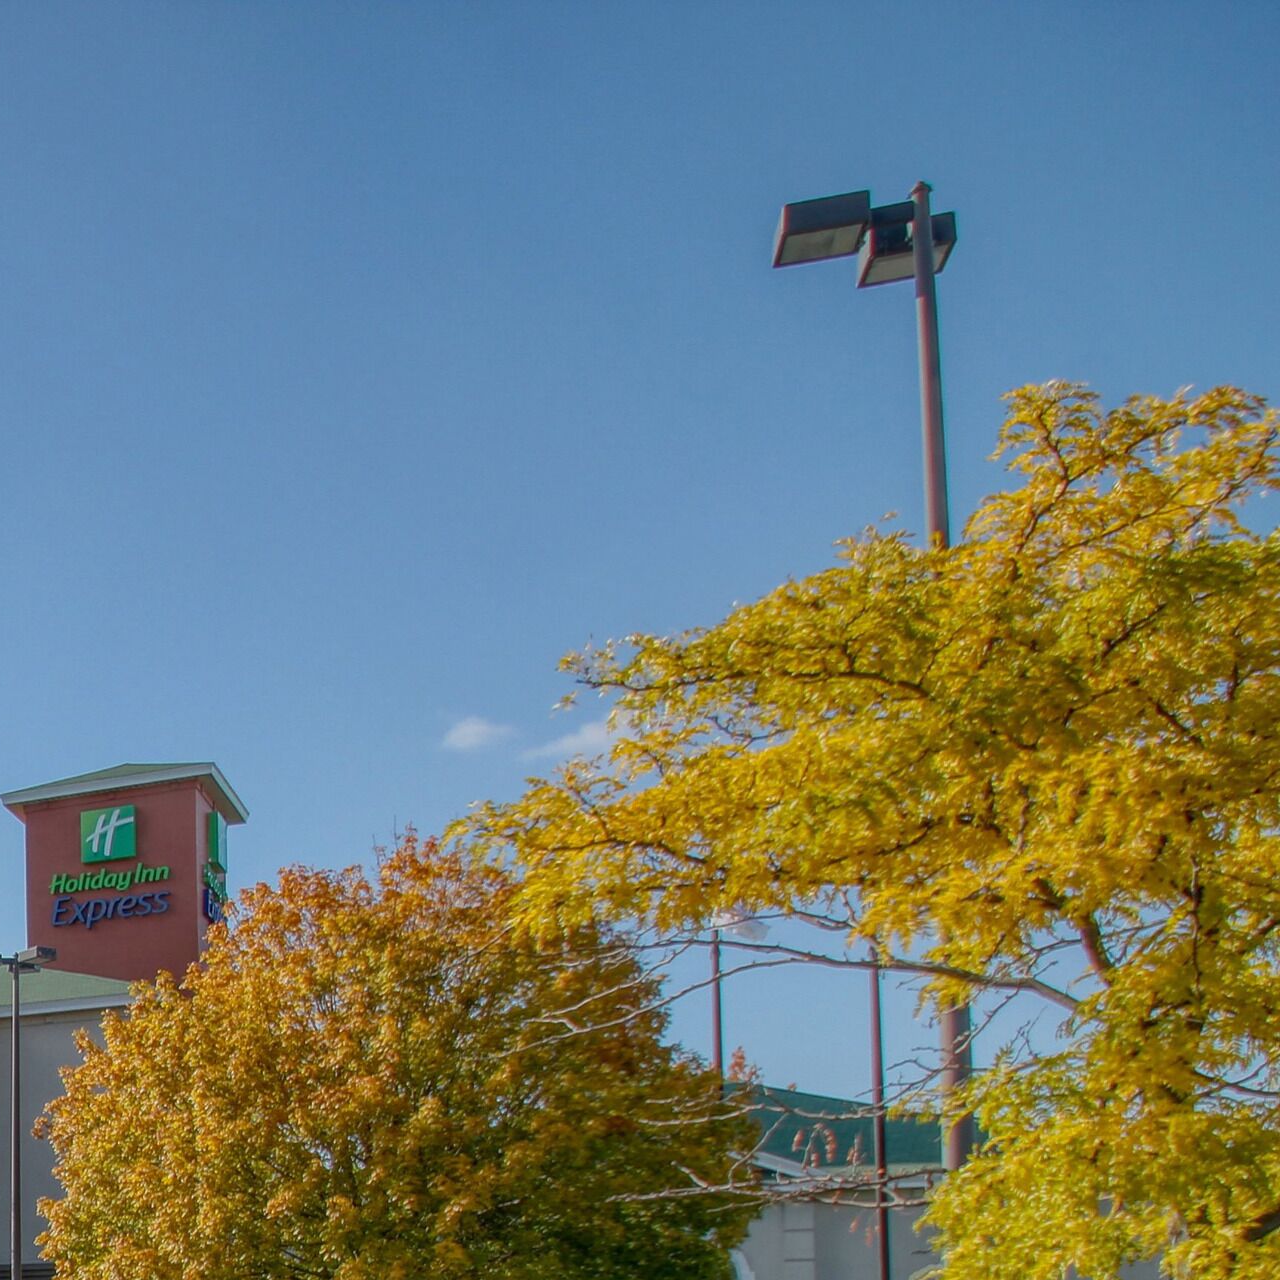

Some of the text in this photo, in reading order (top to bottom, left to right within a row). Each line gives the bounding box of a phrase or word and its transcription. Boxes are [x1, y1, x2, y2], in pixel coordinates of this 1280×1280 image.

[48, 862, 171, 895] Holiday Inn
[50, 891, 170, 928] Express
